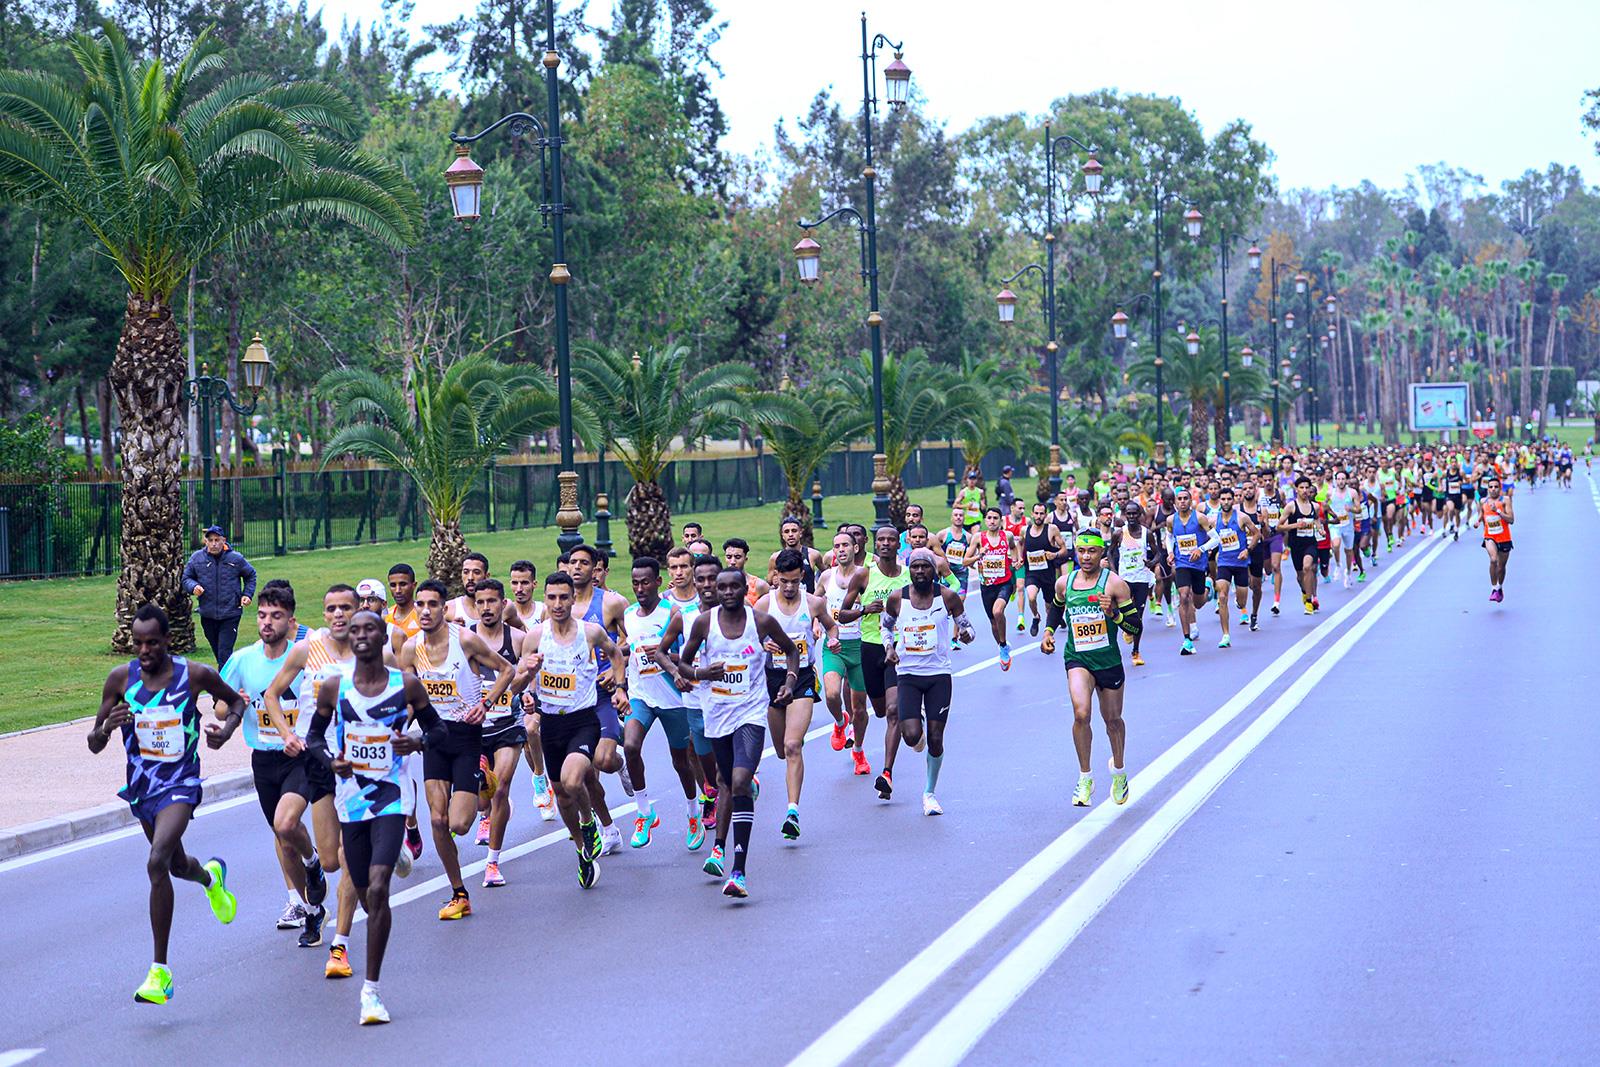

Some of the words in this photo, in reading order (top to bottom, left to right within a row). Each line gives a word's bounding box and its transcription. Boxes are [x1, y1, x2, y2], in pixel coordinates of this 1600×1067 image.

[1077, 623, 1102, 637] 5897
[543, 675, 571, 689] 6200
[427, 683, 453, 696] 5520
[262, 713, 294, 726] 61
[152, 741, 170, 749] 5002
[352, 745, 386, 760] 5033
